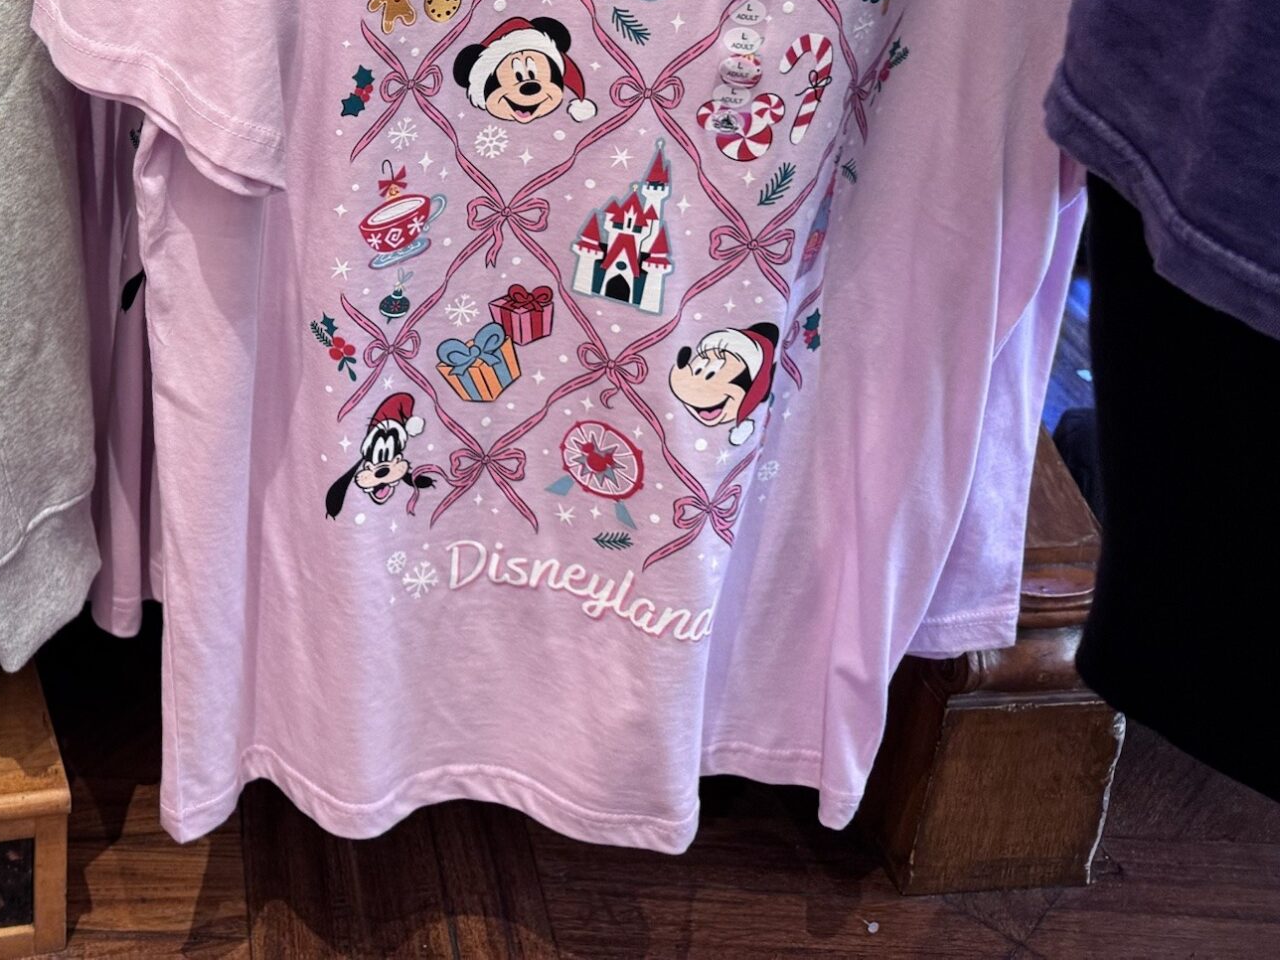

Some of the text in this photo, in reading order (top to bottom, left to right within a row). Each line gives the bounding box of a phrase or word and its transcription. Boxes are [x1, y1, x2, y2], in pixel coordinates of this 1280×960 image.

[747, 3, 753, 12] L
[735, 13, 759, 22] ADULT
[741, 32, 748, 41] L
[731, 42, 754, 51] ADULT
[721, 96, 744, 104] ADULT
[445, 539, 719, 642] Disneyland
